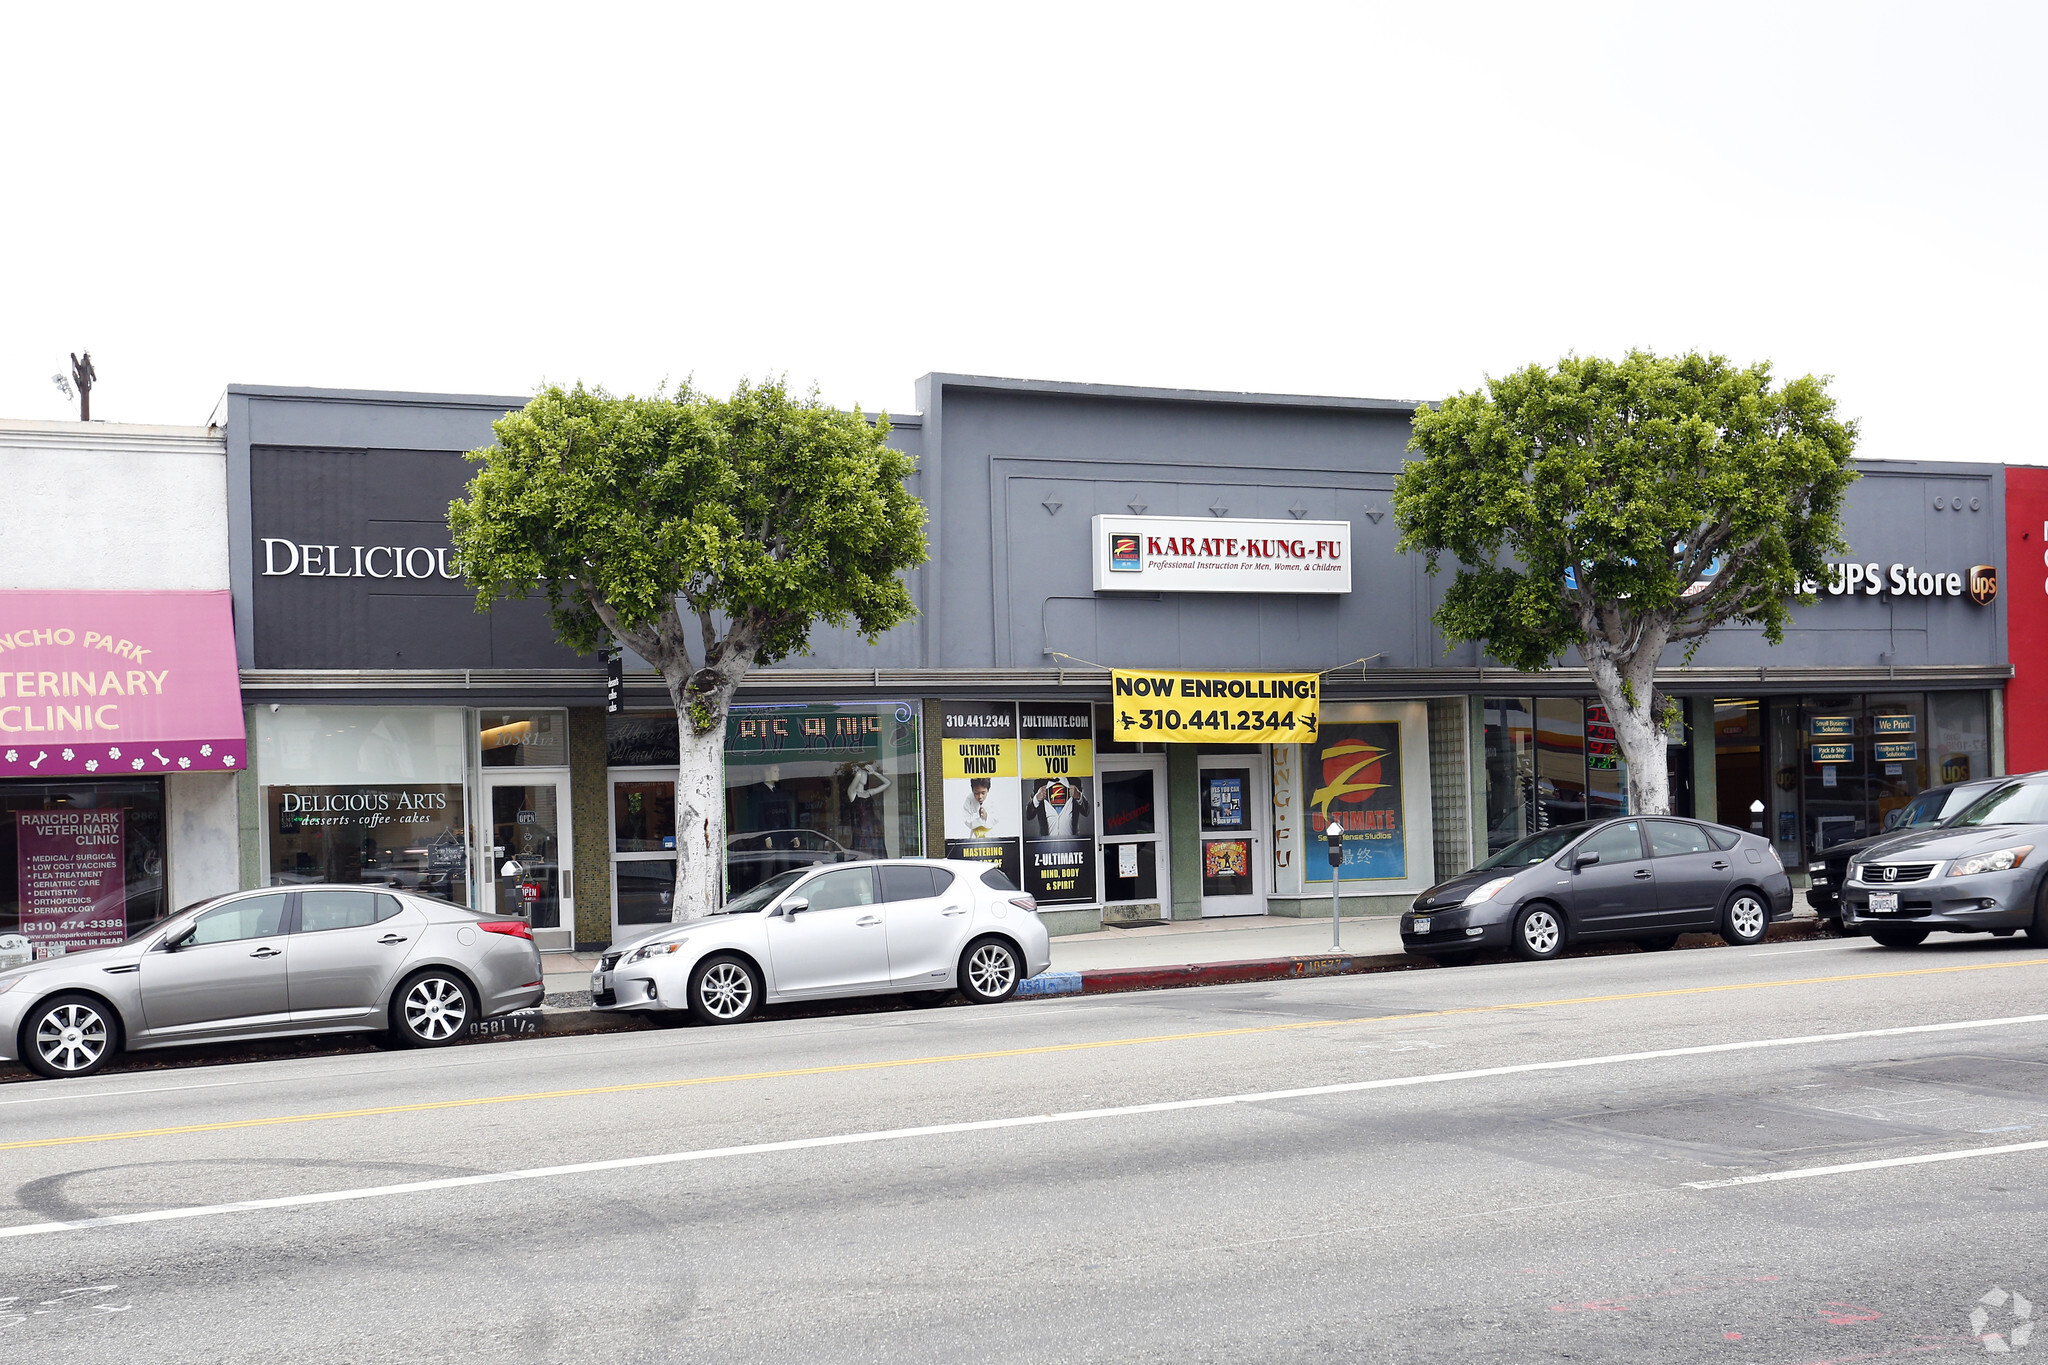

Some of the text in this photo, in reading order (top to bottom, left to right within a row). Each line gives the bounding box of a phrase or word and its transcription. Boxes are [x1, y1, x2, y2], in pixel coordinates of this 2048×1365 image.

[261, 537, 463, 579] DELICIOU
[1148, 560, 1195, 570] Professional
[1197, 561, 1238, 571] Instruction
[1240, 562, 1252, 571] For
[1254, 563, 1272, 572] Men,
[1274, 563, 1302, 572] Women,
[1304, 563, 1310, 571] &
[1312, 563, 1342, 572] Children
[1828, 562, 1883, 596] UPS
[1889, 563, 1962, 596] Store
[1972, 576, 1996, 600] ups
[0, 628, 152, 664] NCHO PARK
[0, 670, 168, 698] TERINARY
[1116, 677, 1317, 699] NOW ENROLLING!
[0, 704, 120, 732] CLINIC
[946, 714, 1010, 728] 310.441.2344
[1022, 715, 1089, 728] ZULTIMATE.COM
[1139, 709, 1296, 731] 310.441.2344
[1880, 720, 1911, 729] We Print
[495, 732, 540, 746] 10581
[959, 744, 1000, 756] ULTIMATE
[1037, 744, 1076, 757] ULTIMATE
[1820, 752, 1845, 760] Guarantee
[1836, 747, 1846, 755] Ship
[964, 757, 997, 775] MIND
[1045, 757, 1069, 774] YOU
[283, 791, 447, 813] DELICIOUS ARTS
[22, 814, 79, 825] RANCHO
[83, 813, 119, 823] PARK
[302, 815, 350, 826] desserts
[358, 813, 390, 829] coffee
[400, 814, 431, 824] cakes
[519, 815, 535, 823] OPEN
[1107, 803, 1150, 830] Welcome
[1312, 810, 1396, 832] UTIMATE
[37, 824, 119, 836] VETERINARY
[1364, 832, 1392, 840] Studios
[76, 835, 120, 846] CLINIC
[75, 853, 116, 861] SURGICAL
[963, 847, 1003, 857] MASTERING
[1034, 852, 1084, 866] Z-ULTIMATE
[1041, 868, 1079, 879] MIND, BODY
[1046, 880, 1075, 890] & SPIRIT
[34, 889, 78, 897] DENTISTRY
[34, 897, 92, 905] ORTHOPEDICS
[34, 905, 96, 914] DERMATOLOGY
[23, 918, 123, 932] (310) 474-3398
